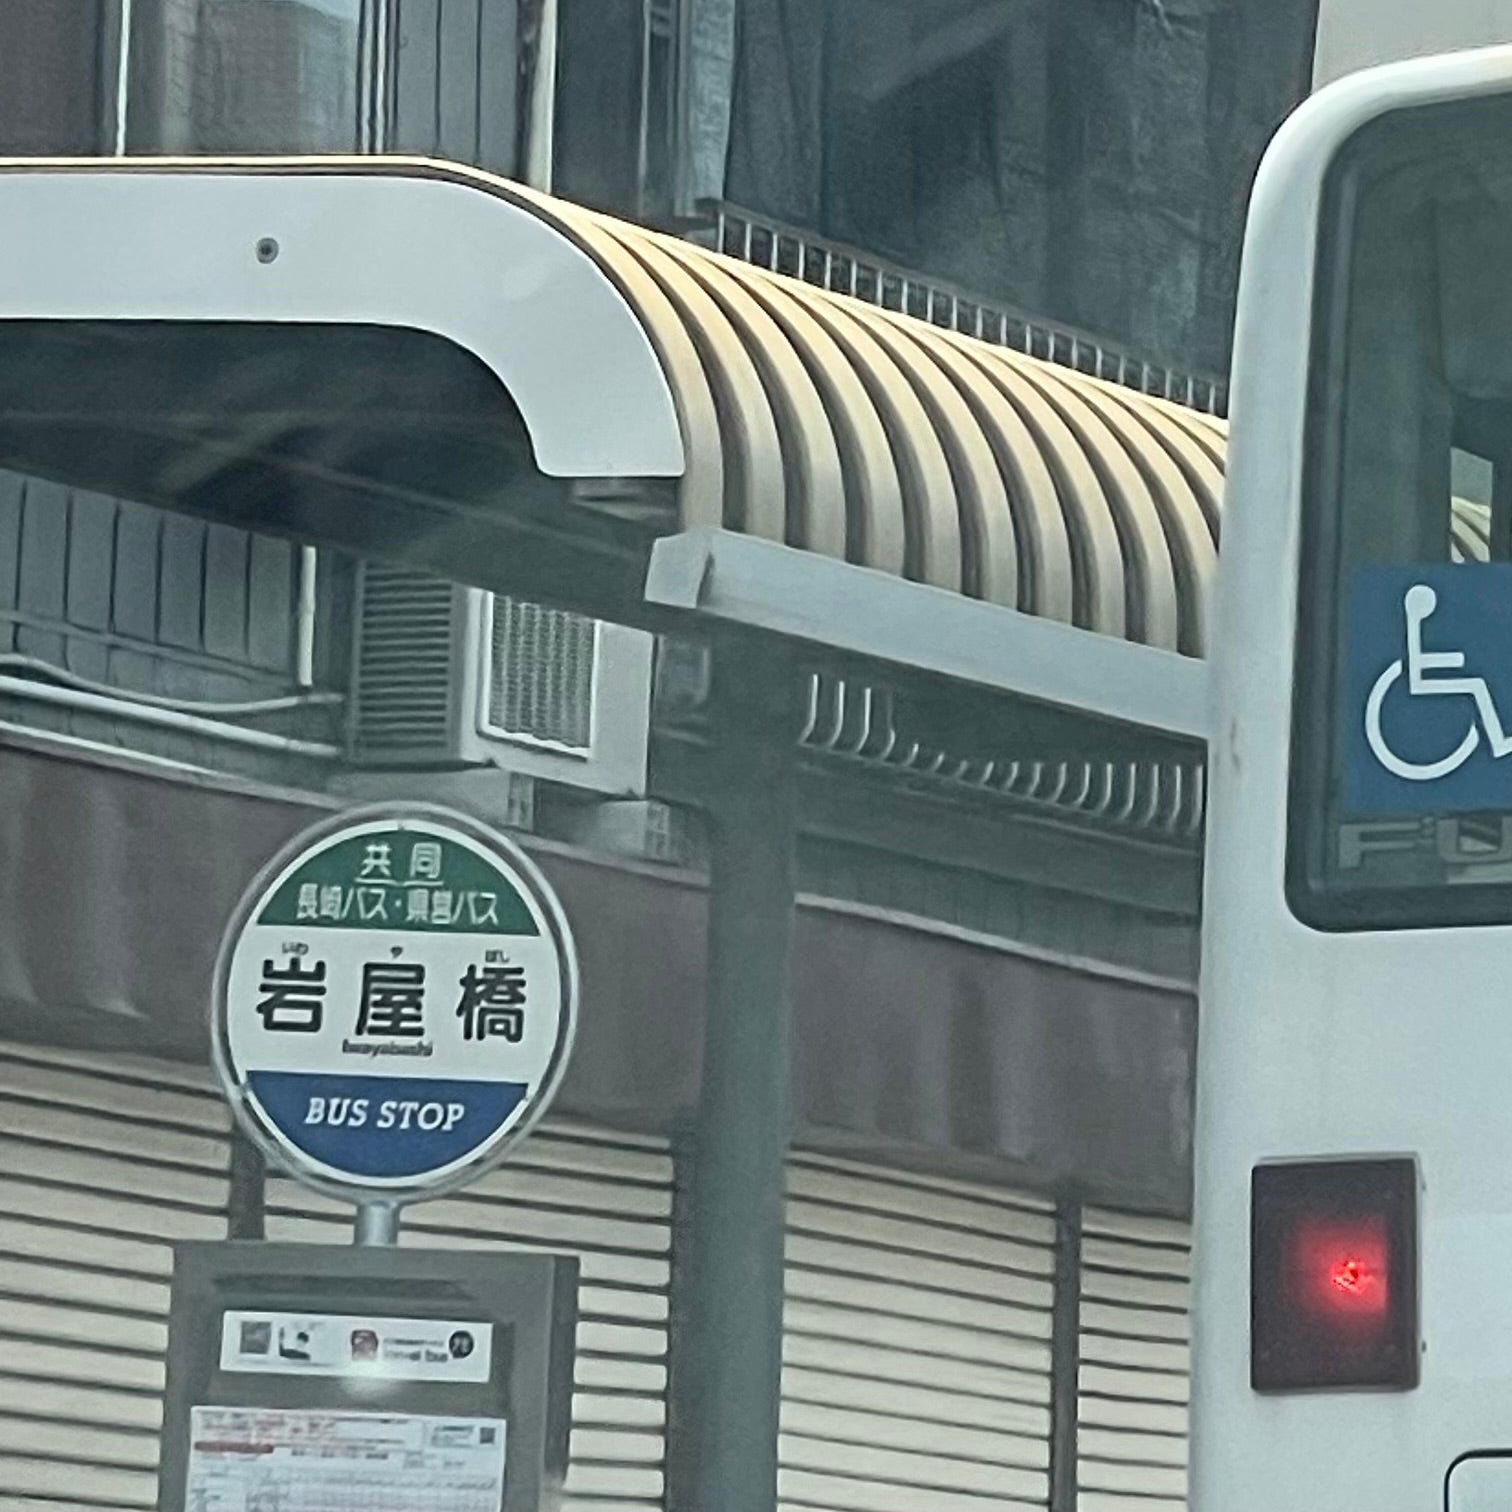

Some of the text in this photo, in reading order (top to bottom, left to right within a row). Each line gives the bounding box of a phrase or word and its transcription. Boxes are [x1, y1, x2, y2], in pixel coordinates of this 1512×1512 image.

[360, 842, 443, 879] 共同
[256, 958, 527, 1043] 岩屋橋
[304, 1096, 466, 1131] BUS STOP
